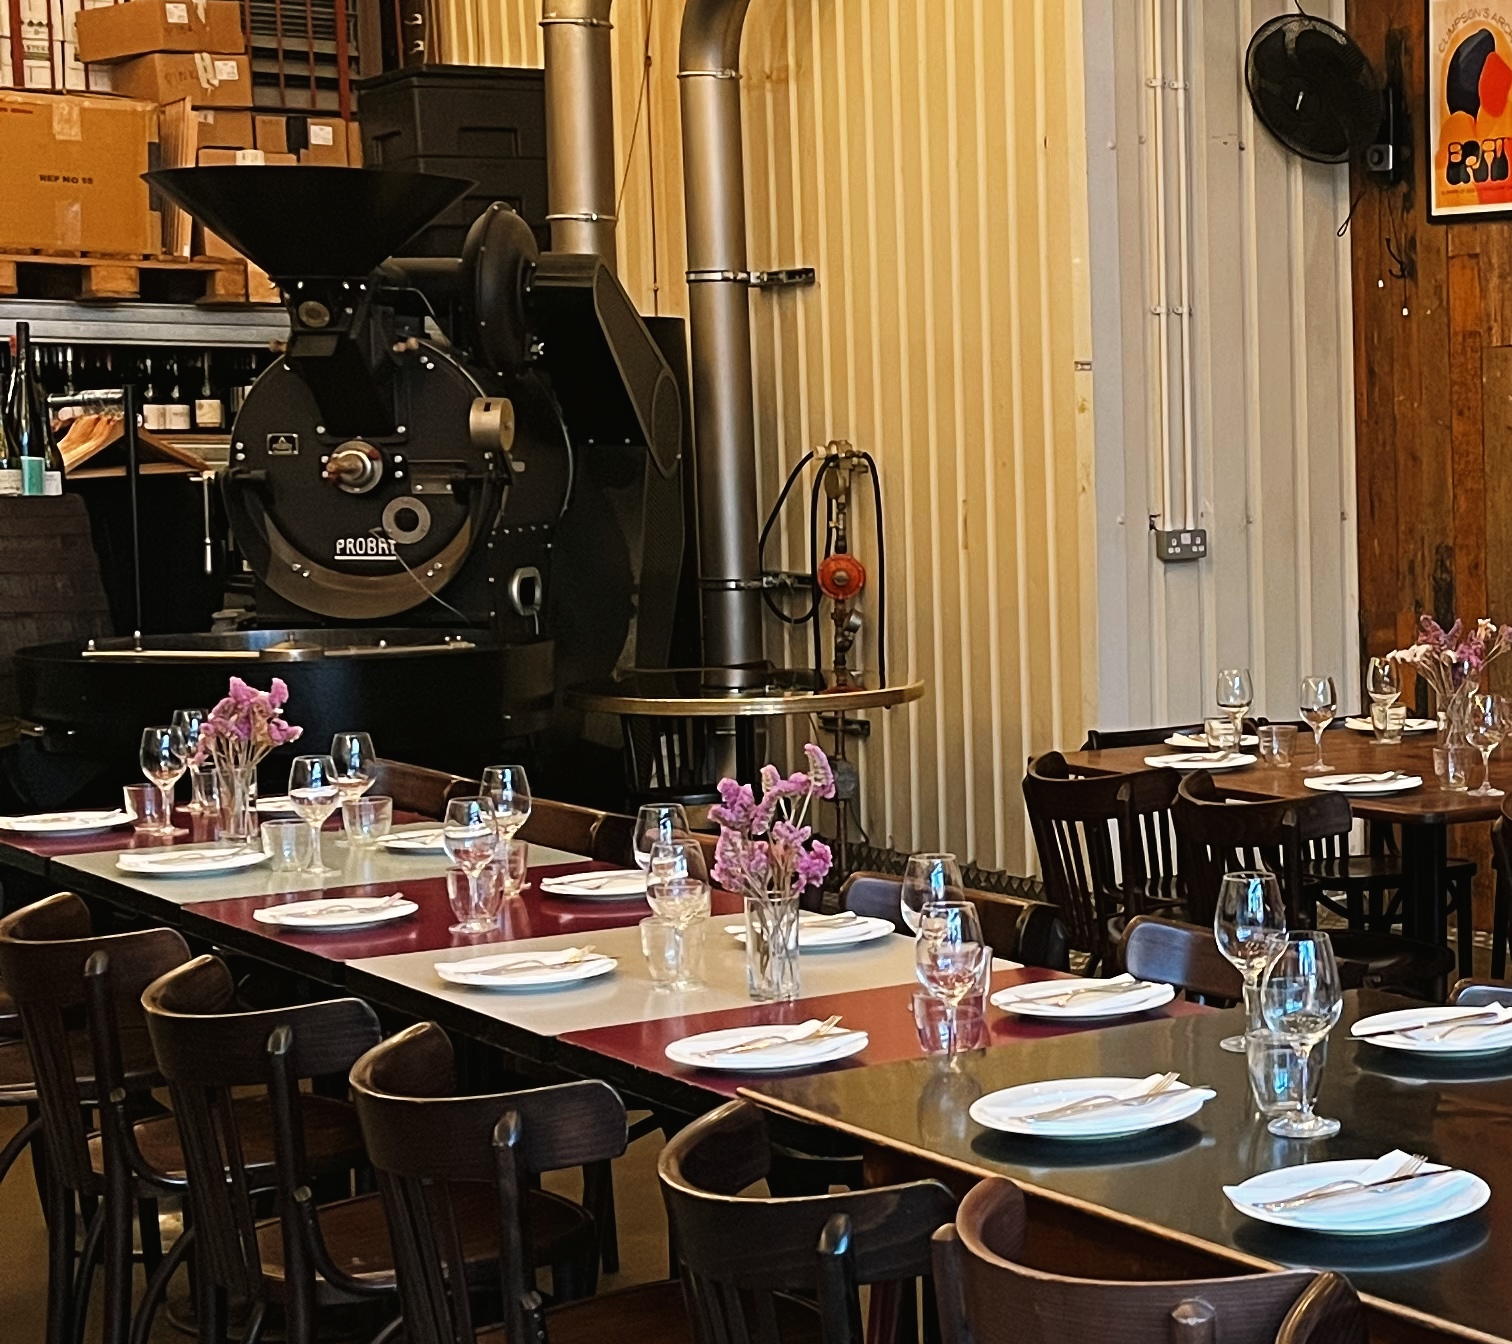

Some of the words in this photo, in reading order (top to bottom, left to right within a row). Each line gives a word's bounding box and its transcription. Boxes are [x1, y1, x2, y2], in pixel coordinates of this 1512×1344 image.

[39, 174, 60, 183] REF
[62, 176, 79, 184] NO
[336, 537, 397, 555] PROBAT
